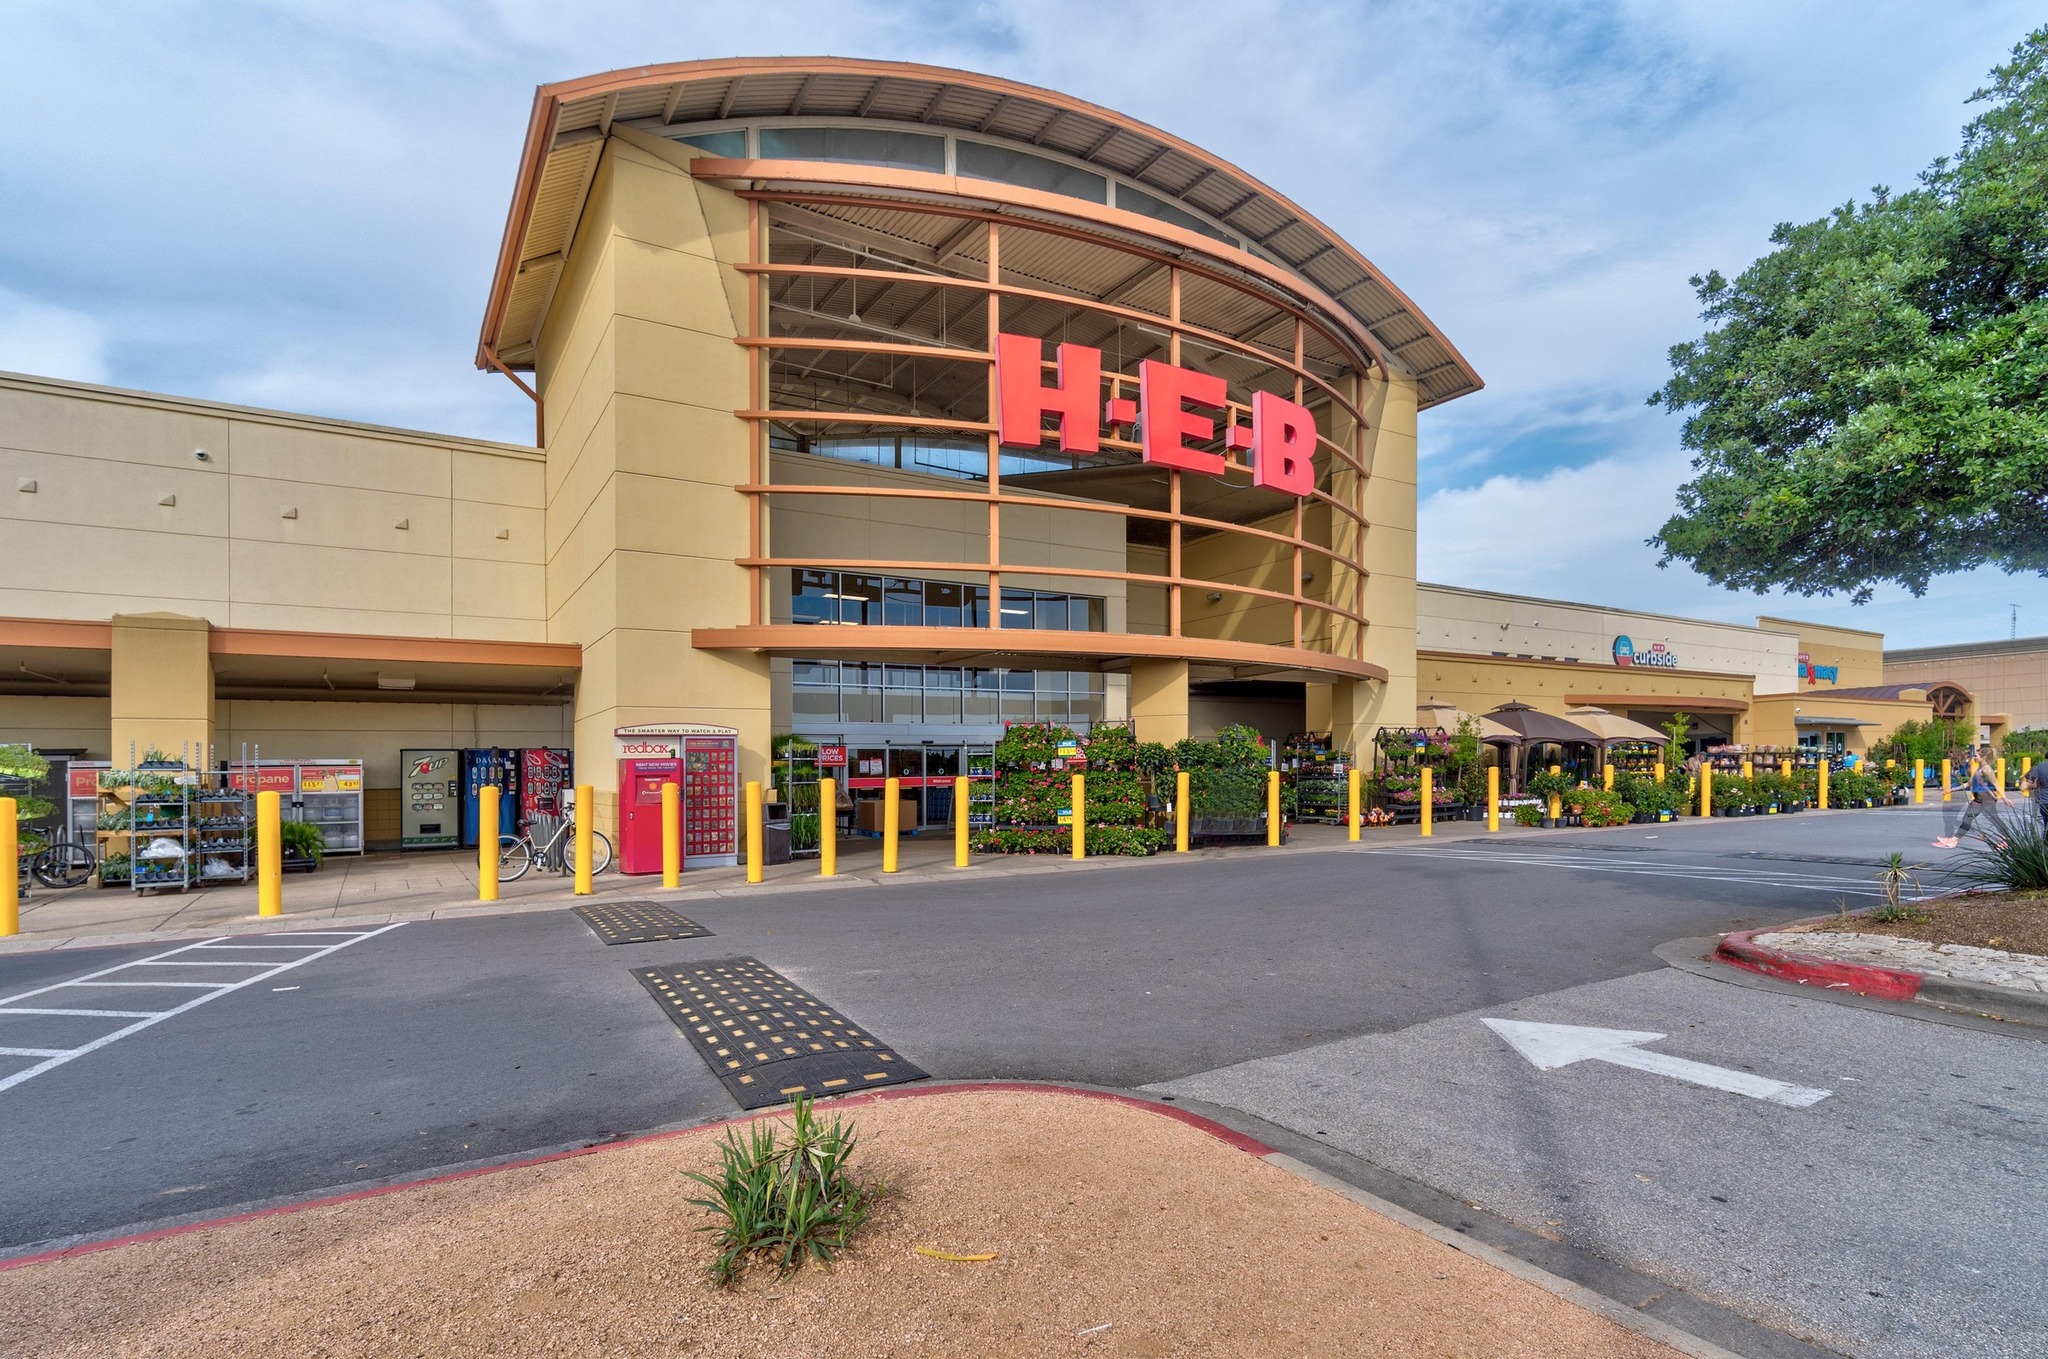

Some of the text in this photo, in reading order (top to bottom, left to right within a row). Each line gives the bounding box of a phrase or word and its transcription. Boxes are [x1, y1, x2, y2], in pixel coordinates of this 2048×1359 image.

[995, 333, 1317, 497] H-E-B
[1632, 650, 1678, 668] curbside
[622, 741, 669, 754] redbox
[409, 756, 449, 778] 7UP
[822, 754, 843, 762] RICES
